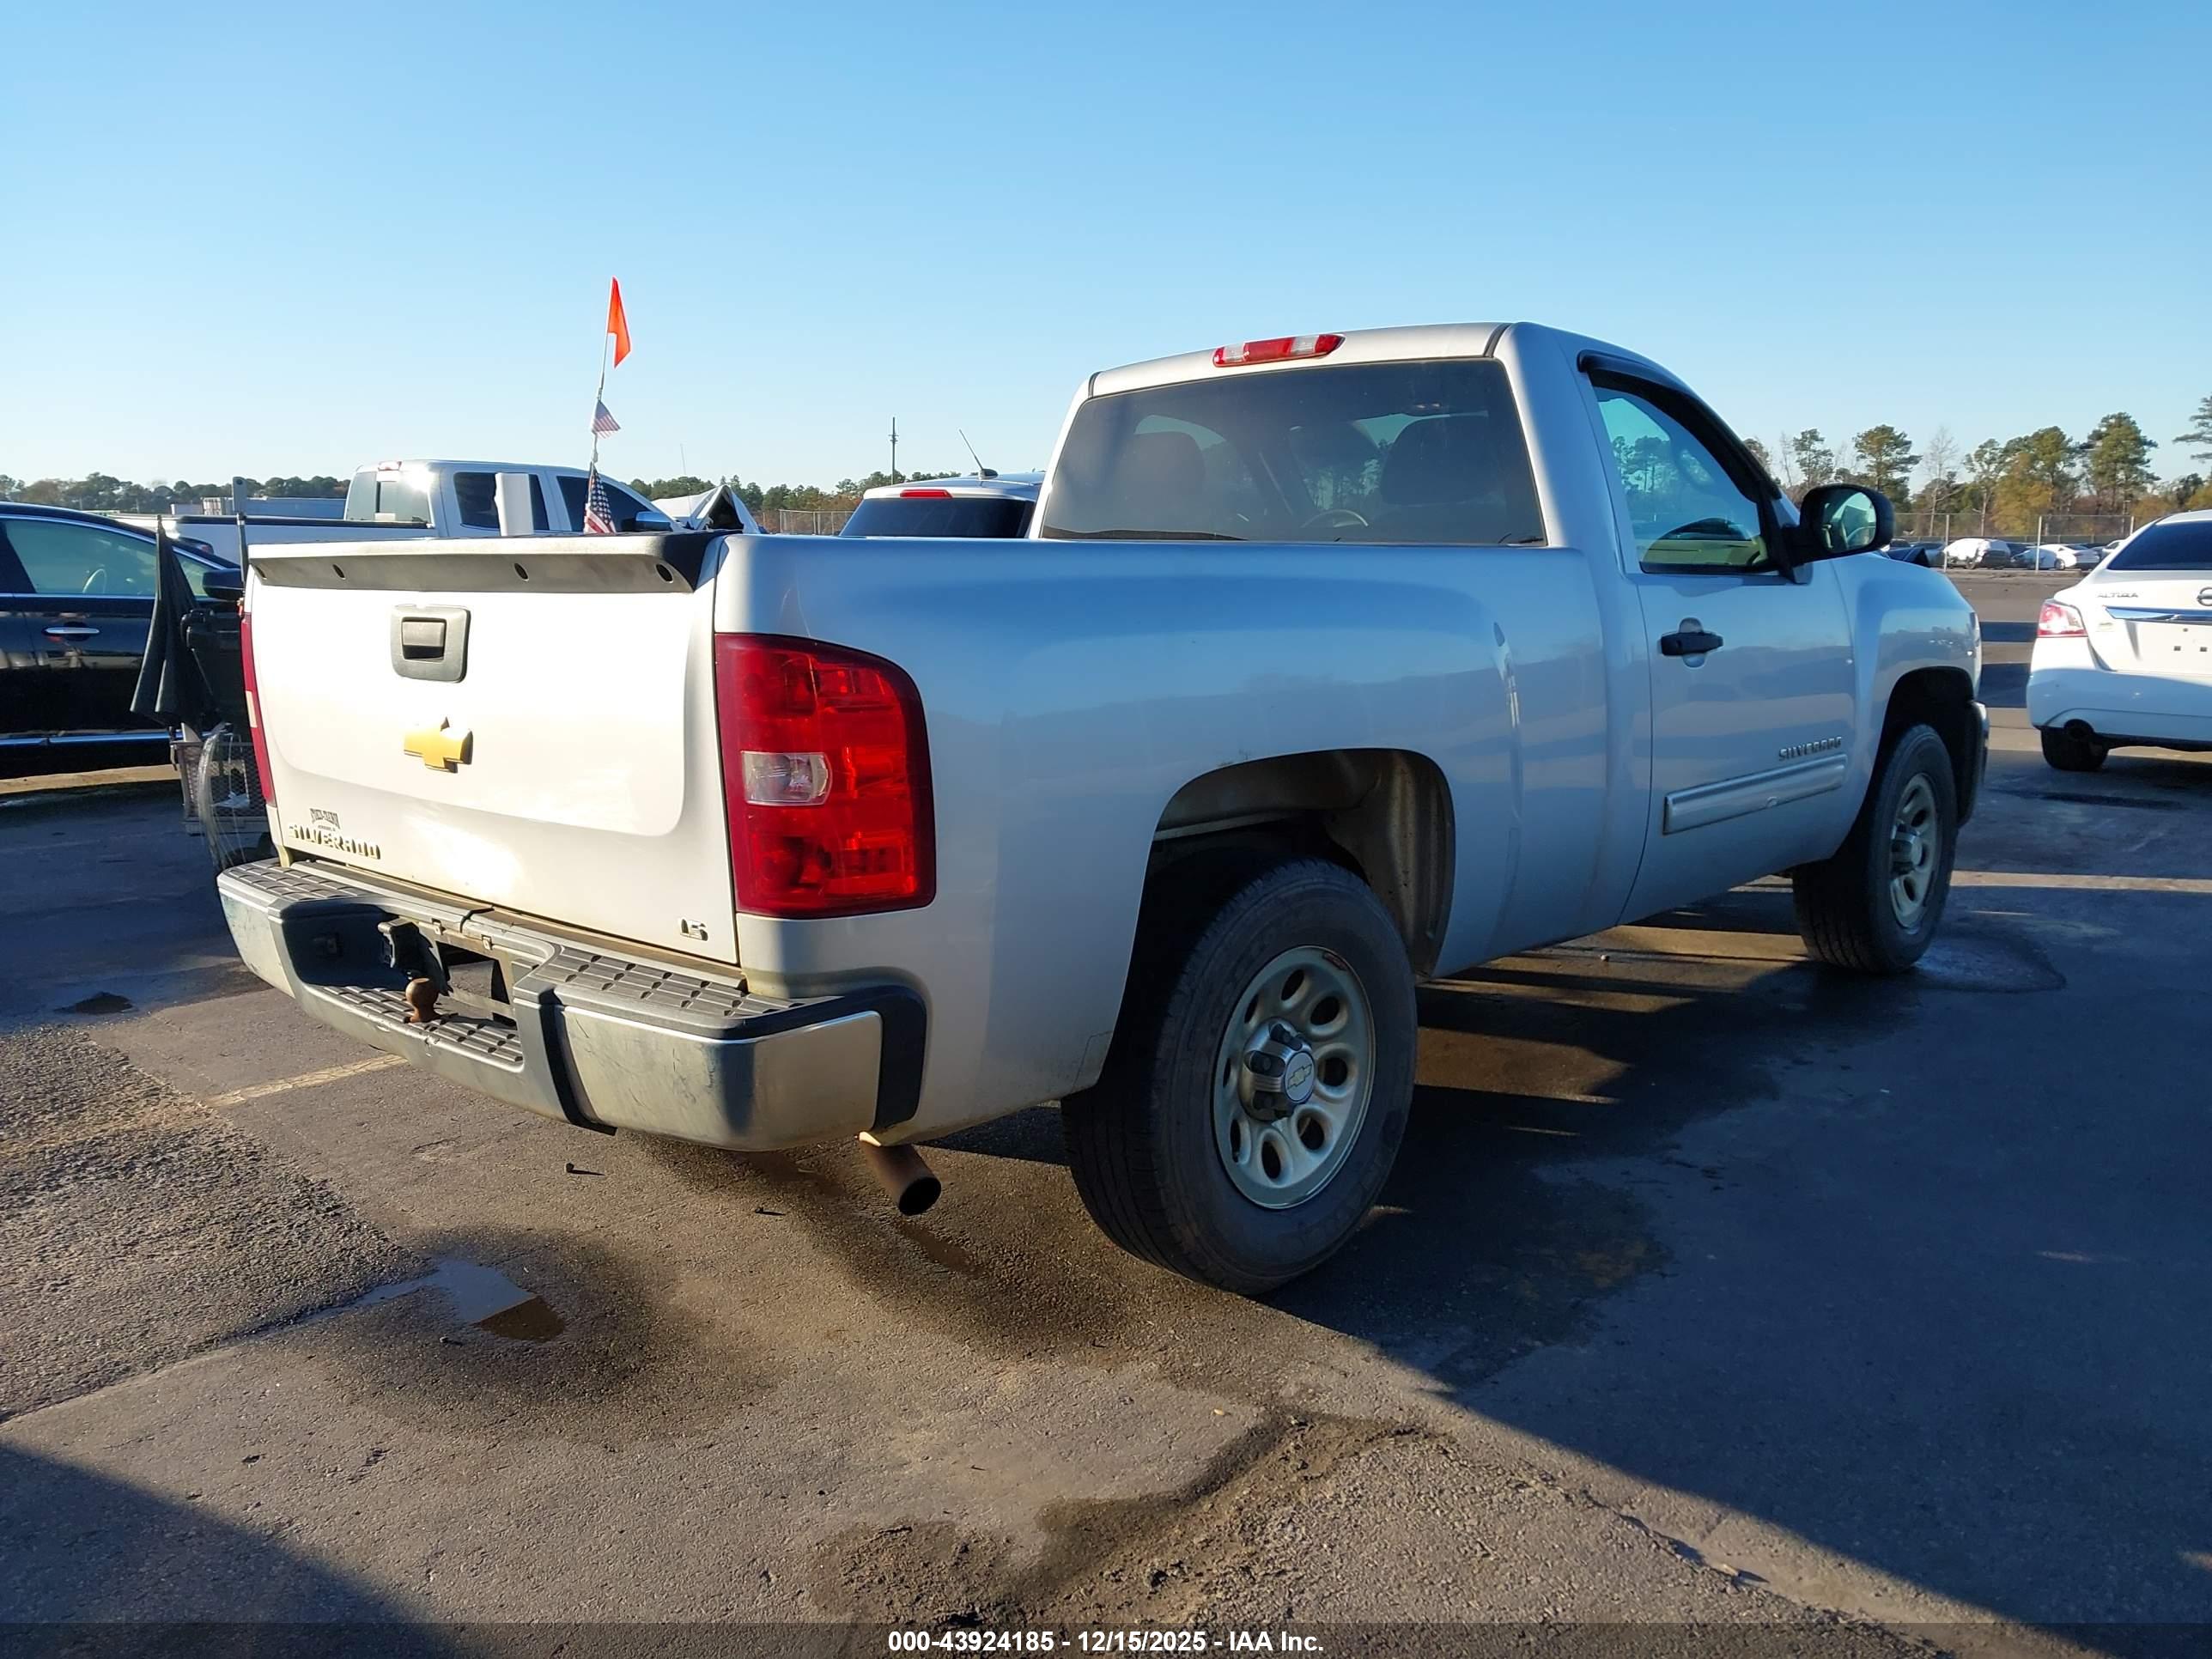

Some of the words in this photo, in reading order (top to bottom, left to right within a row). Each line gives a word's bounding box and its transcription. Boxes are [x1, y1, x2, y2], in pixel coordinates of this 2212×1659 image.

[1778, 736, 1843, 762] SILVERADO
[288, 823, 382, 860] SILVERADO
[679, 918, 709, 942] LS
